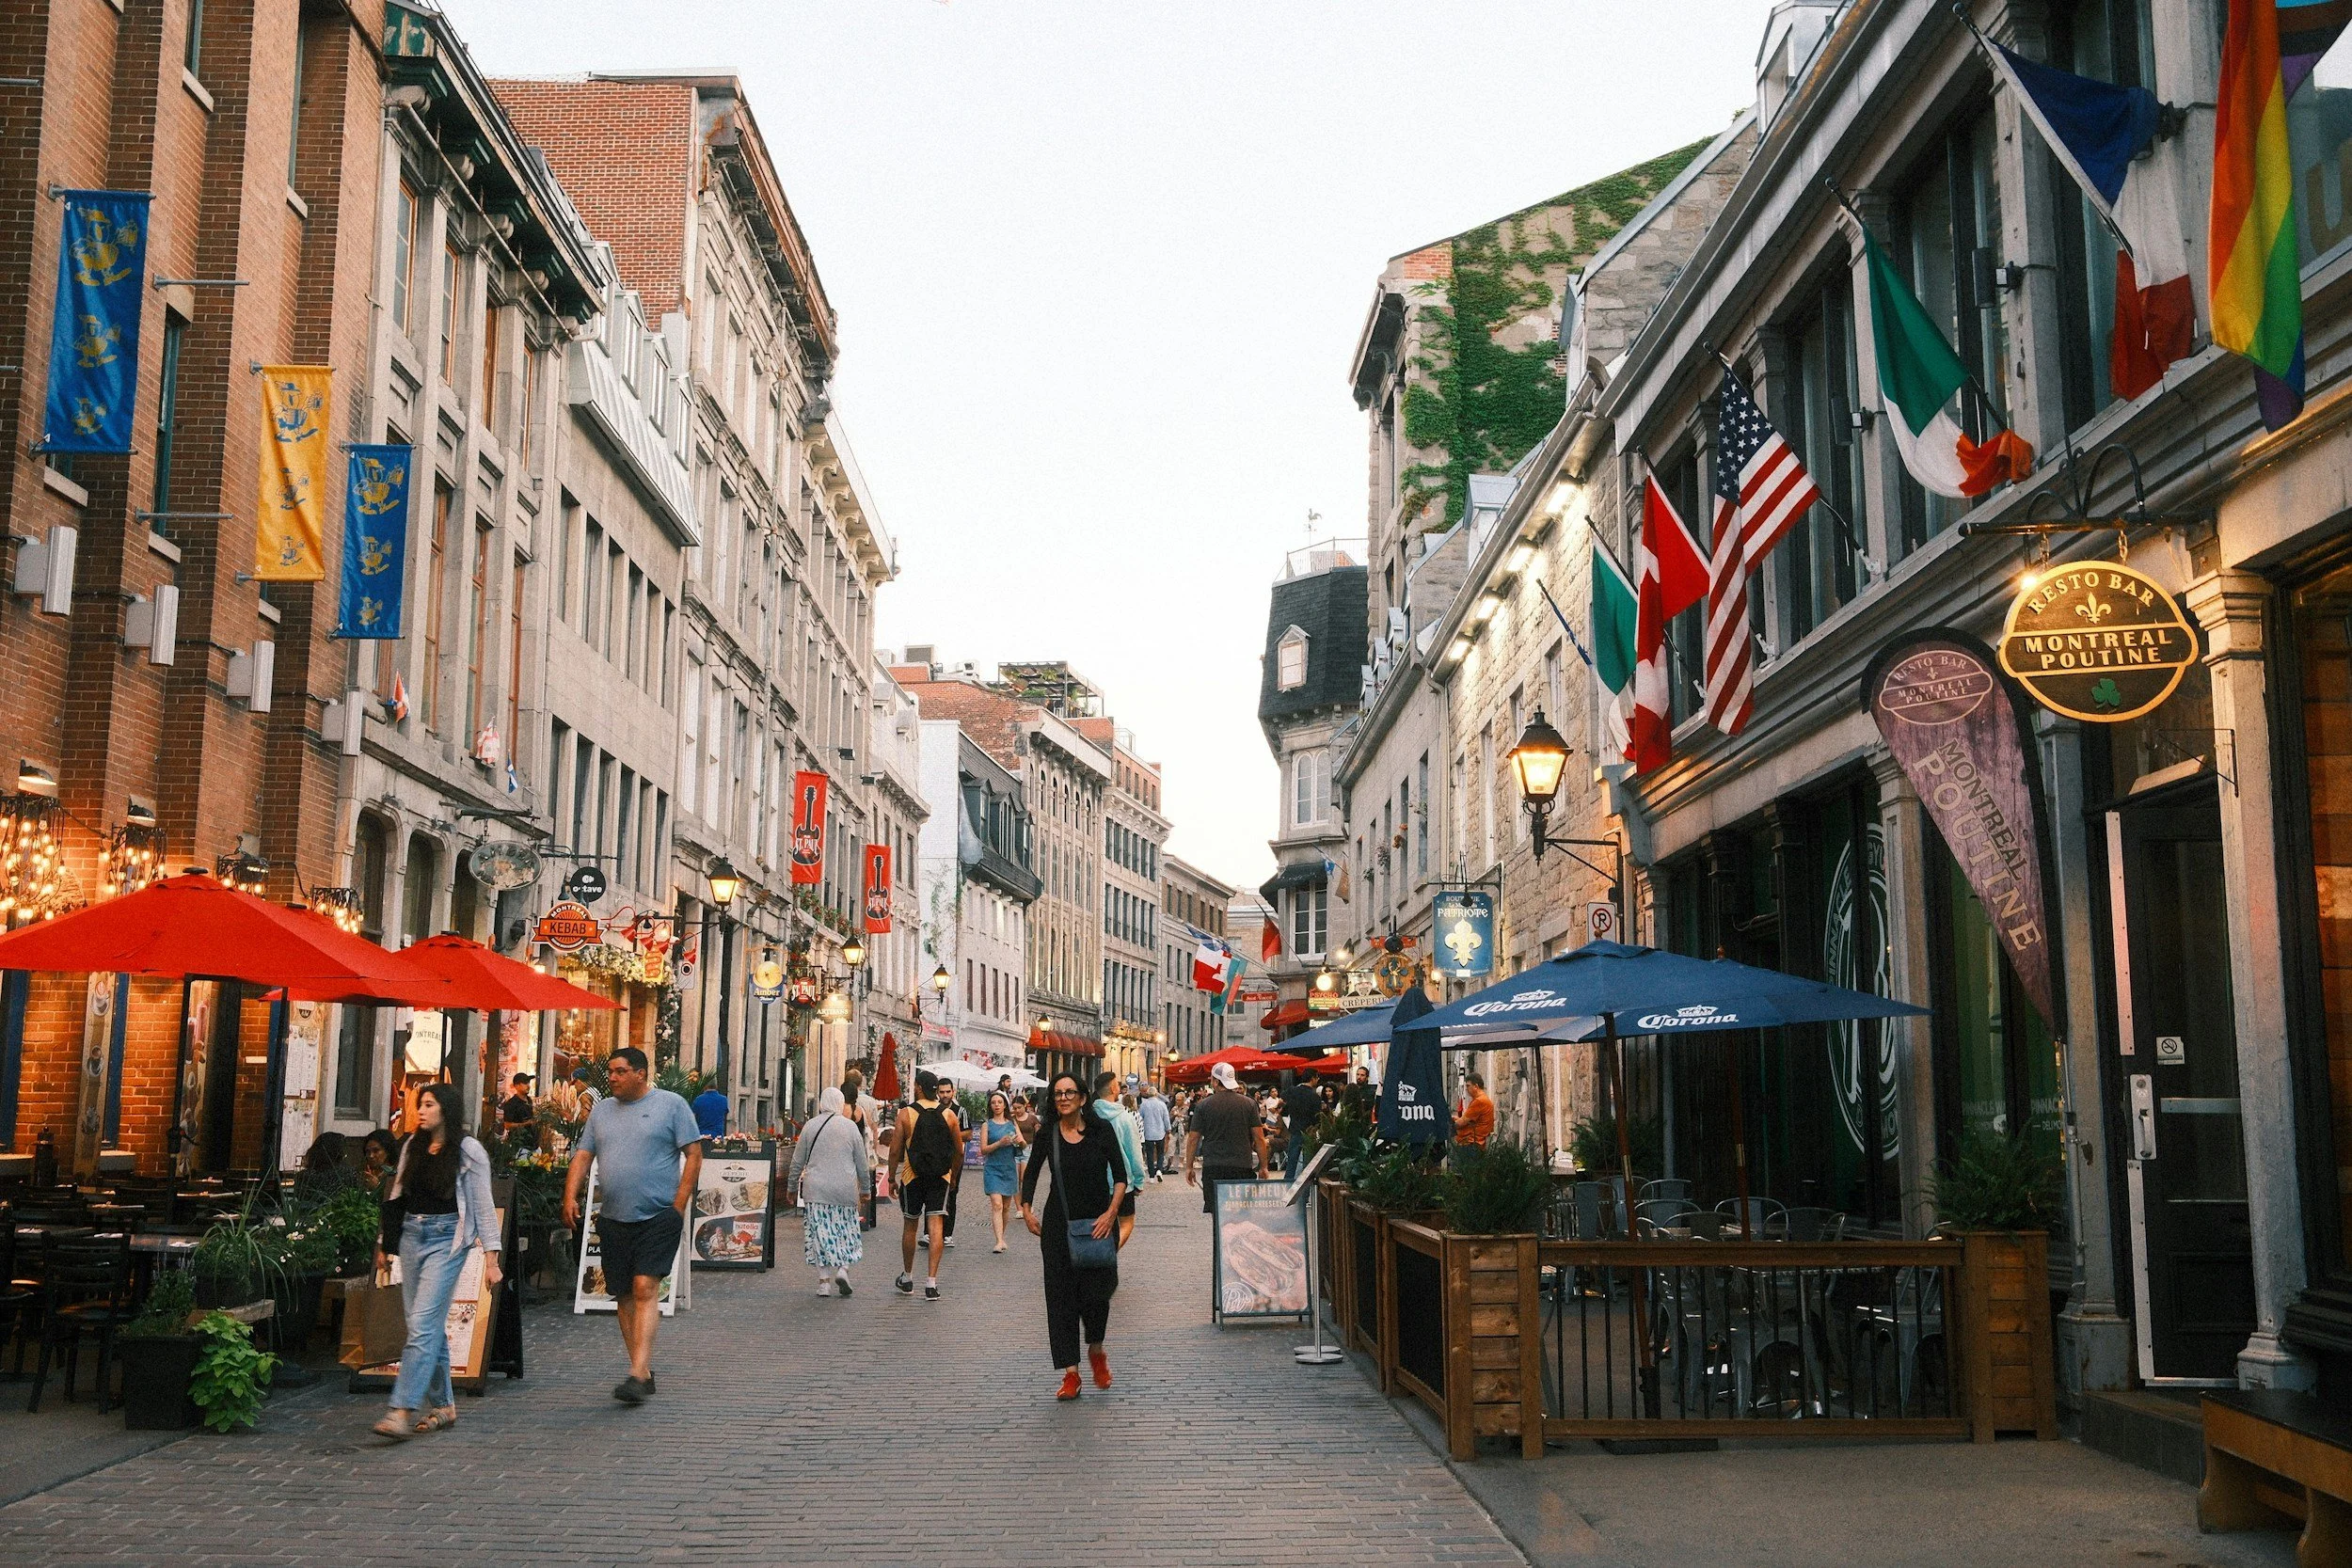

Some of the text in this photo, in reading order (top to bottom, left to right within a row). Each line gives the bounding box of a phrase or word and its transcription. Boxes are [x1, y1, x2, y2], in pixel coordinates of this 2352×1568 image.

[2027, 571, 2154, 615] RESTO BAR
[2025, 628, 2172, 654] MONTREAL
[1893, 656, 1967, 681] RESTO BAR
[2040, 647, 2162, 671] POUTINE
[1898, 678, 1973, 698] MONTREAL
[1906, 687, 1968, 704] POUTINE
[1938, 737, 2027, 880] MONTREAL
[1913, 750, 2042, 951] POUTINE
[572, 884, 602, 893] otave
[550, 905, 587, 919] MONTREAL
[549, 922, 586, 934] KEBAB
[754, 988, 781, 996] Amber
[1464, 997, 1566, 1017] Corona
[1637, 1014, 1739, 1030] Corona
[1229, 1185, 1241, 1198] LE
